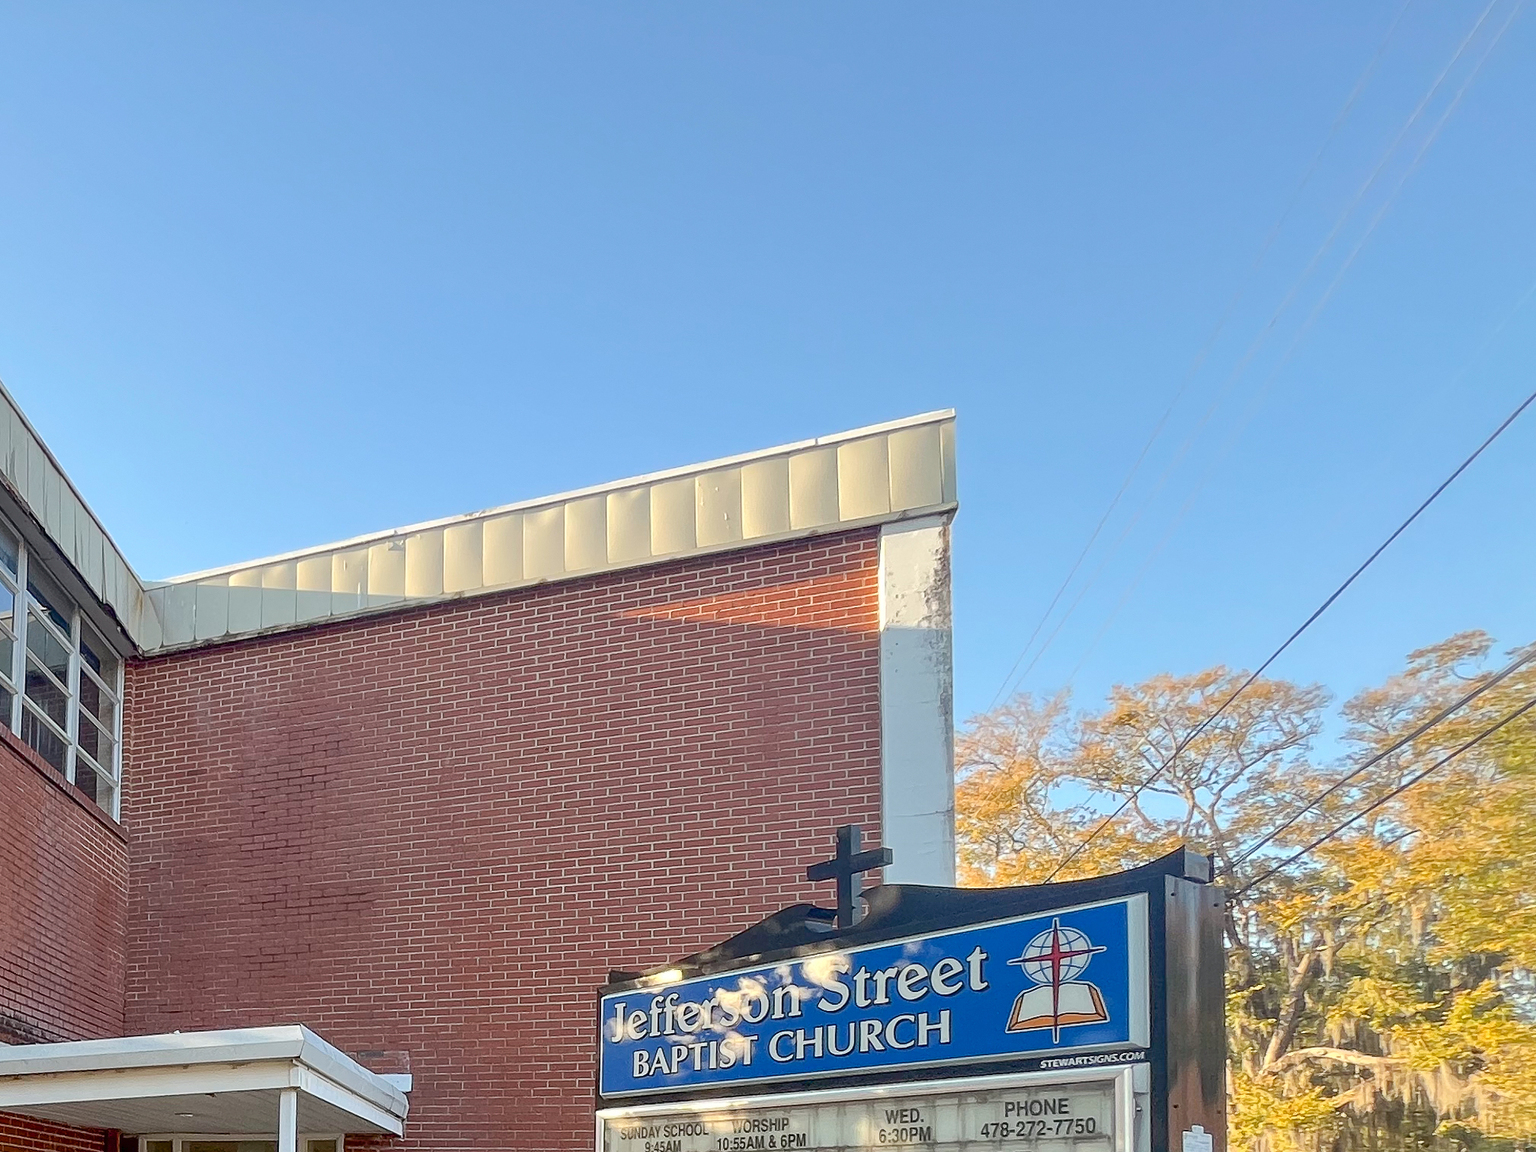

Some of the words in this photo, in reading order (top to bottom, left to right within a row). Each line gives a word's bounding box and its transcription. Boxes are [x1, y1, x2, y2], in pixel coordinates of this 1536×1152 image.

[611, 984, 802, 1044] Jefferson
[817, 946, 989, 1013] Street
[632, 1035, 758, 1078] BAPTIST
[768, 1009, 951, 1063] CHURCH
[1039, 1051, 1145, 1069] STEWARTSIGNS.COM
[885, 1107, 925, 1125] WED.
[1004, 1098, 1070, 1118] PHONE
[620, 1125, 661, 1141] SUNDAY
[663, 1122, 710, 1138] SCHOOL
[732, 1117, 790, 1134] WORSHIP
[980, 1117, 1097, 1139] 478-272-7750
[717, 1136, 765, 1151] 10:55AM
[768, 1136, 777, 1149] &
[780, 1133, 807, 1148] 6PM
[878, 1126, 932, 1144] 6:30PM
